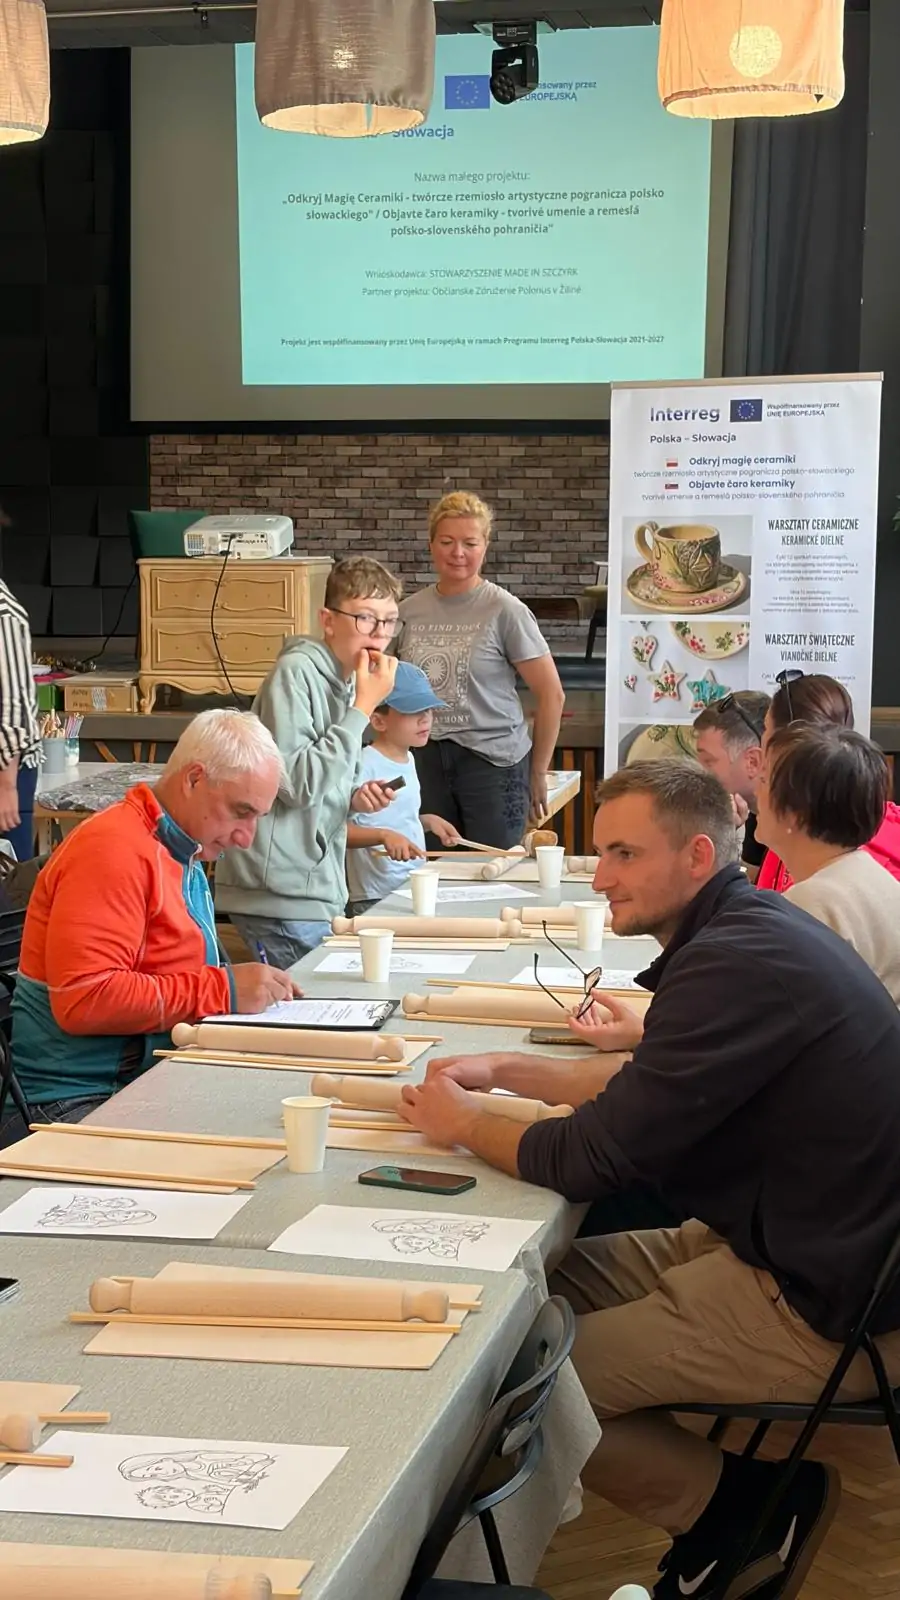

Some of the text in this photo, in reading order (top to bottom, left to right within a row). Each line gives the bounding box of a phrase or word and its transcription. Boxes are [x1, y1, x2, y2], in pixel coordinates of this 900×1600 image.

[576, 82, 596, 90] przez
[520, 92, 577, 102] UROPEJSKĄ
[414, 172, 446, 182] Nazwa
[486, 171, 530, 184] projektu:
[324, 194, 355, 206] Magię
[358, 192, 403, 203] Ceramiki
[412, 192, 453, 202] twórcze
[508, 190, 568, 203] artystyczne
[570, 190, 627, 202] pogranicza
[630, 188, 664, 200] polsko
[382, 209, 422, 221] Objavte
[425, 208, 446, 218] čaro
[450, 208, 499, 220] keramiky
[508, 207, 544, 217] tvorivé
[546, 206, 586, 217] umenie
[430, 269, 502, 278] STOWARZYSZENIE
[504, 269, 528, 277] MADE
[530, 269, 540, 277] IN
[542, 268, 578, 277] SZCZYRK
[362, 288, 392, 296] Partner
[394, 287, 430, 298] projektu:
[518, 286, 551, 295] Polonus
[281, 338, 306, 346] Projekt
[308, 338, 321, 346] jest
[409, 338, 426, 346] Unię
[427, 338, 466, 346] Europejską
[503, 337, 538, 346] Programu
[540, 336, 569, 346] Interreg
[650, 407, 720, 422] Interreg
[650, 434, 682, 444] Polska
[692, 433, 736, 444] Słowacja
[689, 455, 796, 467] Odkryj magię ceramiki
[697, 470, 737, 478] artystyczne
[739, 468, 779, 476] pogranicza
[689, 478, 795, 490] Objavte čaro keramiky
[768, 518, 859, 530] WARSZTATY CERAMICZNE
[781, 533, 844, 545] KERAMICKÉ DIELNE
[765, 632, 855, 648] WARSZTATY ŚWIĄTECZNE
[781, 649, 837, 662] VIANOČNÉ DIELNE
